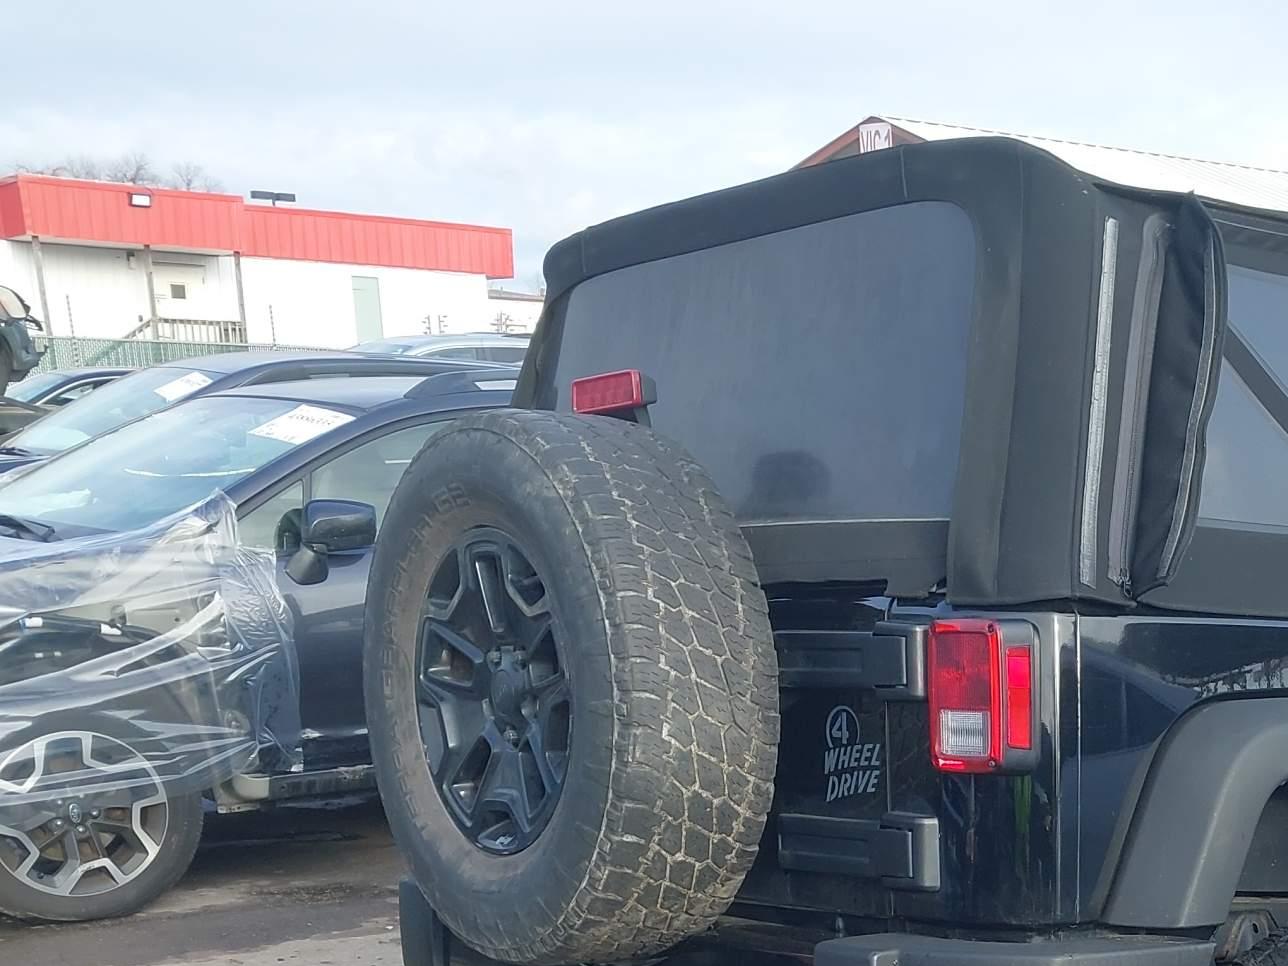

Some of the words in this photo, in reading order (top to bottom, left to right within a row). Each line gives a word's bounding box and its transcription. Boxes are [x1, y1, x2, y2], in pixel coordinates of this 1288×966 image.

[831, 711, 849, 745] 4
[824, 743, 881, 775] WHEEL
[825, 770, 881, 803] DRIVE
